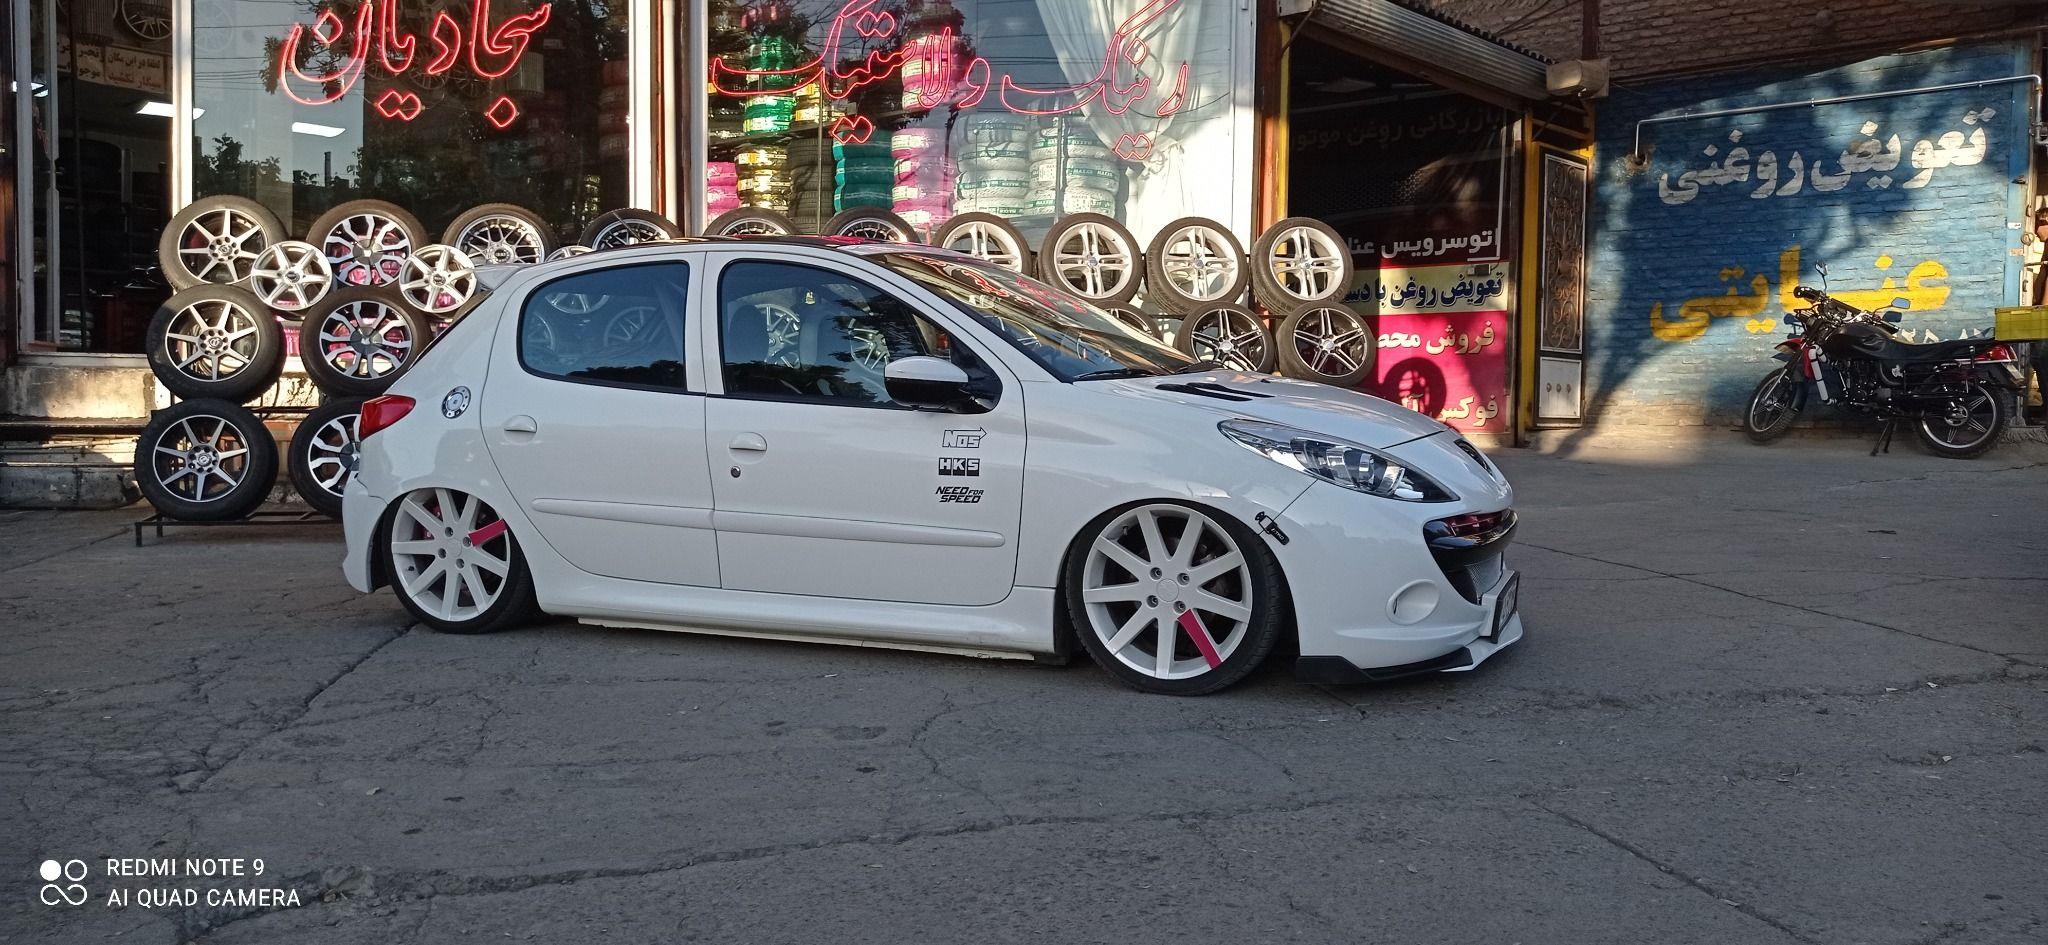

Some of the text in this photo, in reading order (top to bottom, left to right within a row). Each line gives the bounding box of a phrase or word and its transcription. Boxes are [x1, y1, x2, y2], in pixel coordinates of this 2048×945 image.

[957, 57, 991, 109] و
[1657, 106, 1997, 206] تعویض روغنی
[1347, 236, 1375, 255] عنا
[1373, 276, 1387, 307] با
[1390, 276, 1438, 309] روغن
[1440, 271, 1505, 307] تعویض
[1650, 243, 1952, 342] عنایتی
[1377, 320, 1495, 355] فروش محص
[942, 429, 982, 449] NOS
[939, 458, 980, 472] HKS
[935, 486, 970, 495] NEED
[939, 495, 982, 503] SPEED
